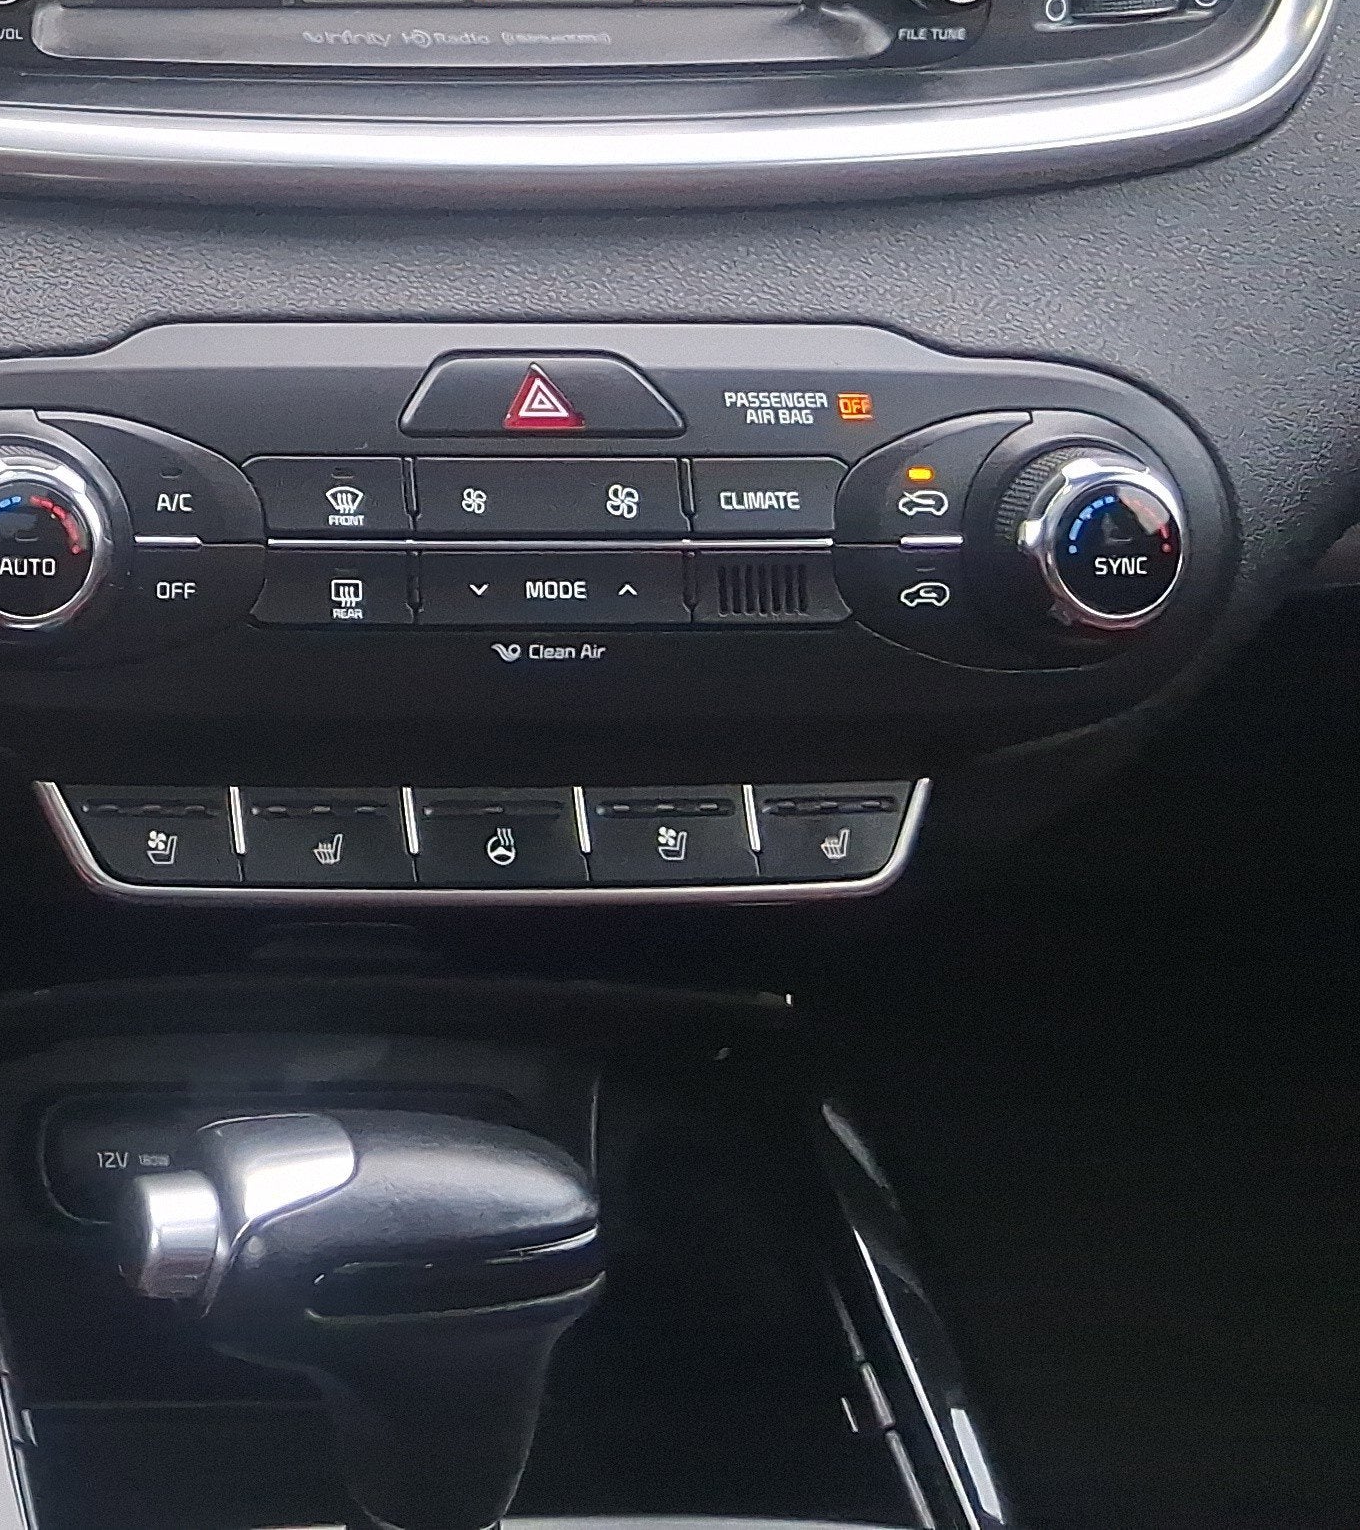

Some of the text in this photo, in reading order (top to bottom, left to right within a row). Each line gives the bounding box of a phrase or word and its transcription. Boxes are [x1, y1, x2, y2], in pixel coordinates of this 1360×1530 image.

[898, 27, 966, 41] FILE TUNE
[724, 392, 828, 408] PASSENGER
[746, 409, 814, 425] AIR BAG
[156, 492, 193, 512] A/C
[720, 491, 801, 510] CLIMATE
[328, 515, 364, 526] FRONT
[1094, 556, 1148, 576] SYNC
[156, 582, 196, 600] OFF
[525, 580, 588, 599] MODE
[332, 608, 363, 619] REAR
[528, 643, 607, 660] Clean Air
[96, 1151, 129, 1168] 12V
